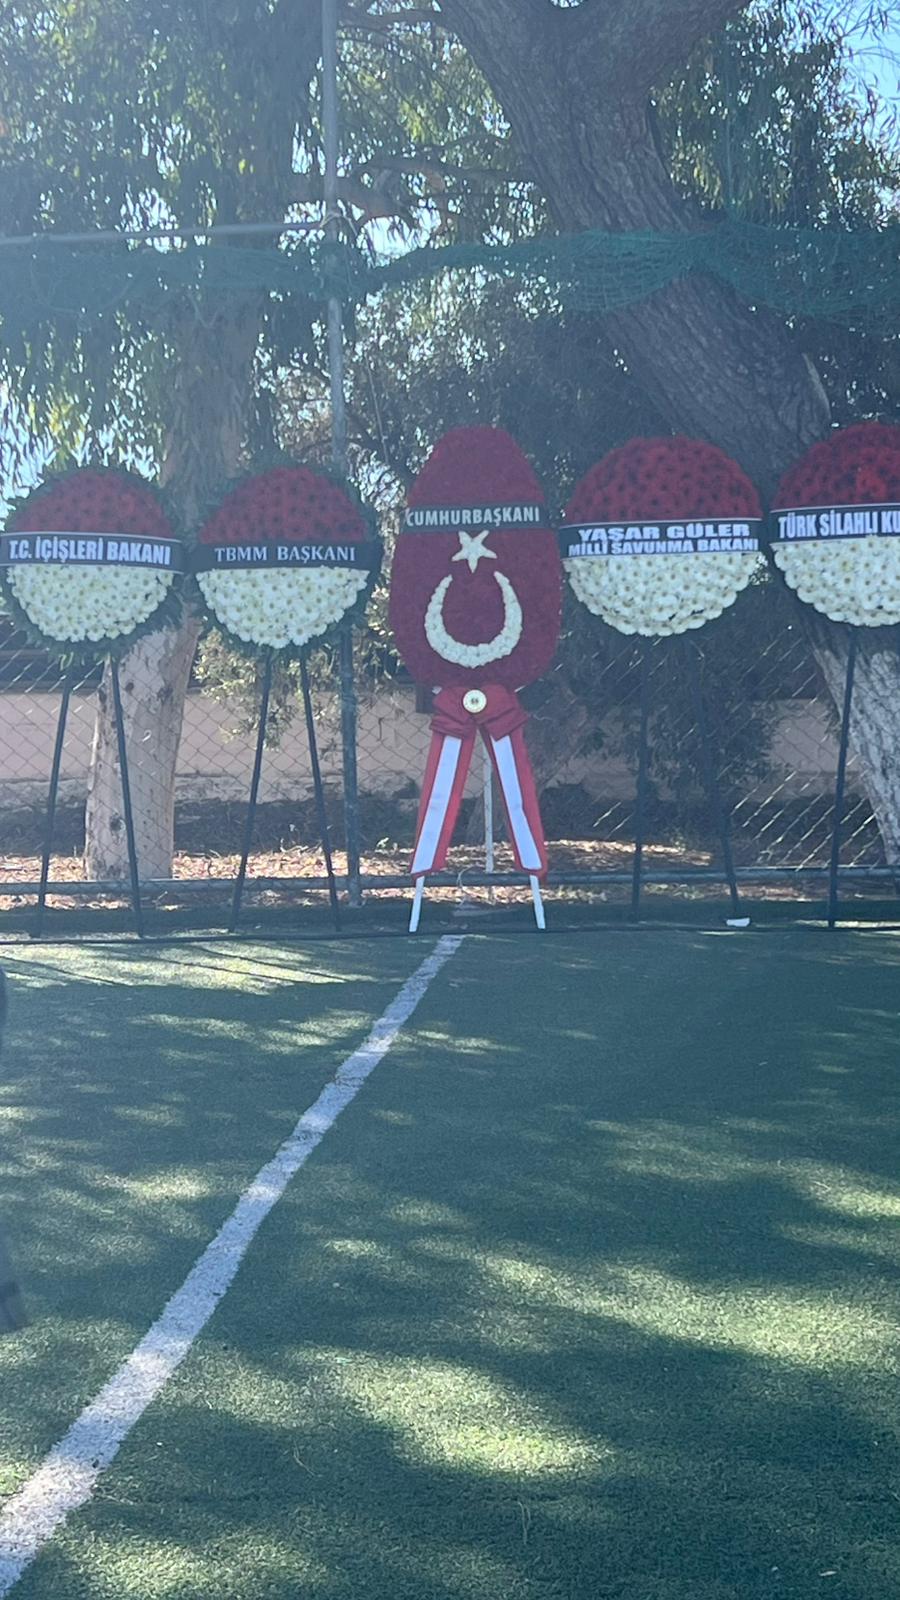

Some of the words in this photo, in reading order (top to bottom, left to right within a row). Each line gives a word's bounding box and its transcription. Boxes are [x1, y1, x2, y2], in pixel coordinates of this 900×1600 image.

[405, 506, 540, 527] CUMHURBAŞKANI
[778, 512, 817, 538] TÜRK
[819, 509, 878, 536] SİLAHLI
[578, 526, 660, 542] YAŞAR
[667, 523, 750, 539] GÜLER
[9, 540, 32, 560] T.C.
[35, 536, 103, 563] İÇİŞLERİ
[107, 541, 171, 565] BAKANI
[214, 546, 267, 562] TBMM
[277, 545, 356, 563] BAŞKANI
[611, 539, 694, 555] SAVUNMA
[697, 538, 759, 551] BAKANI
